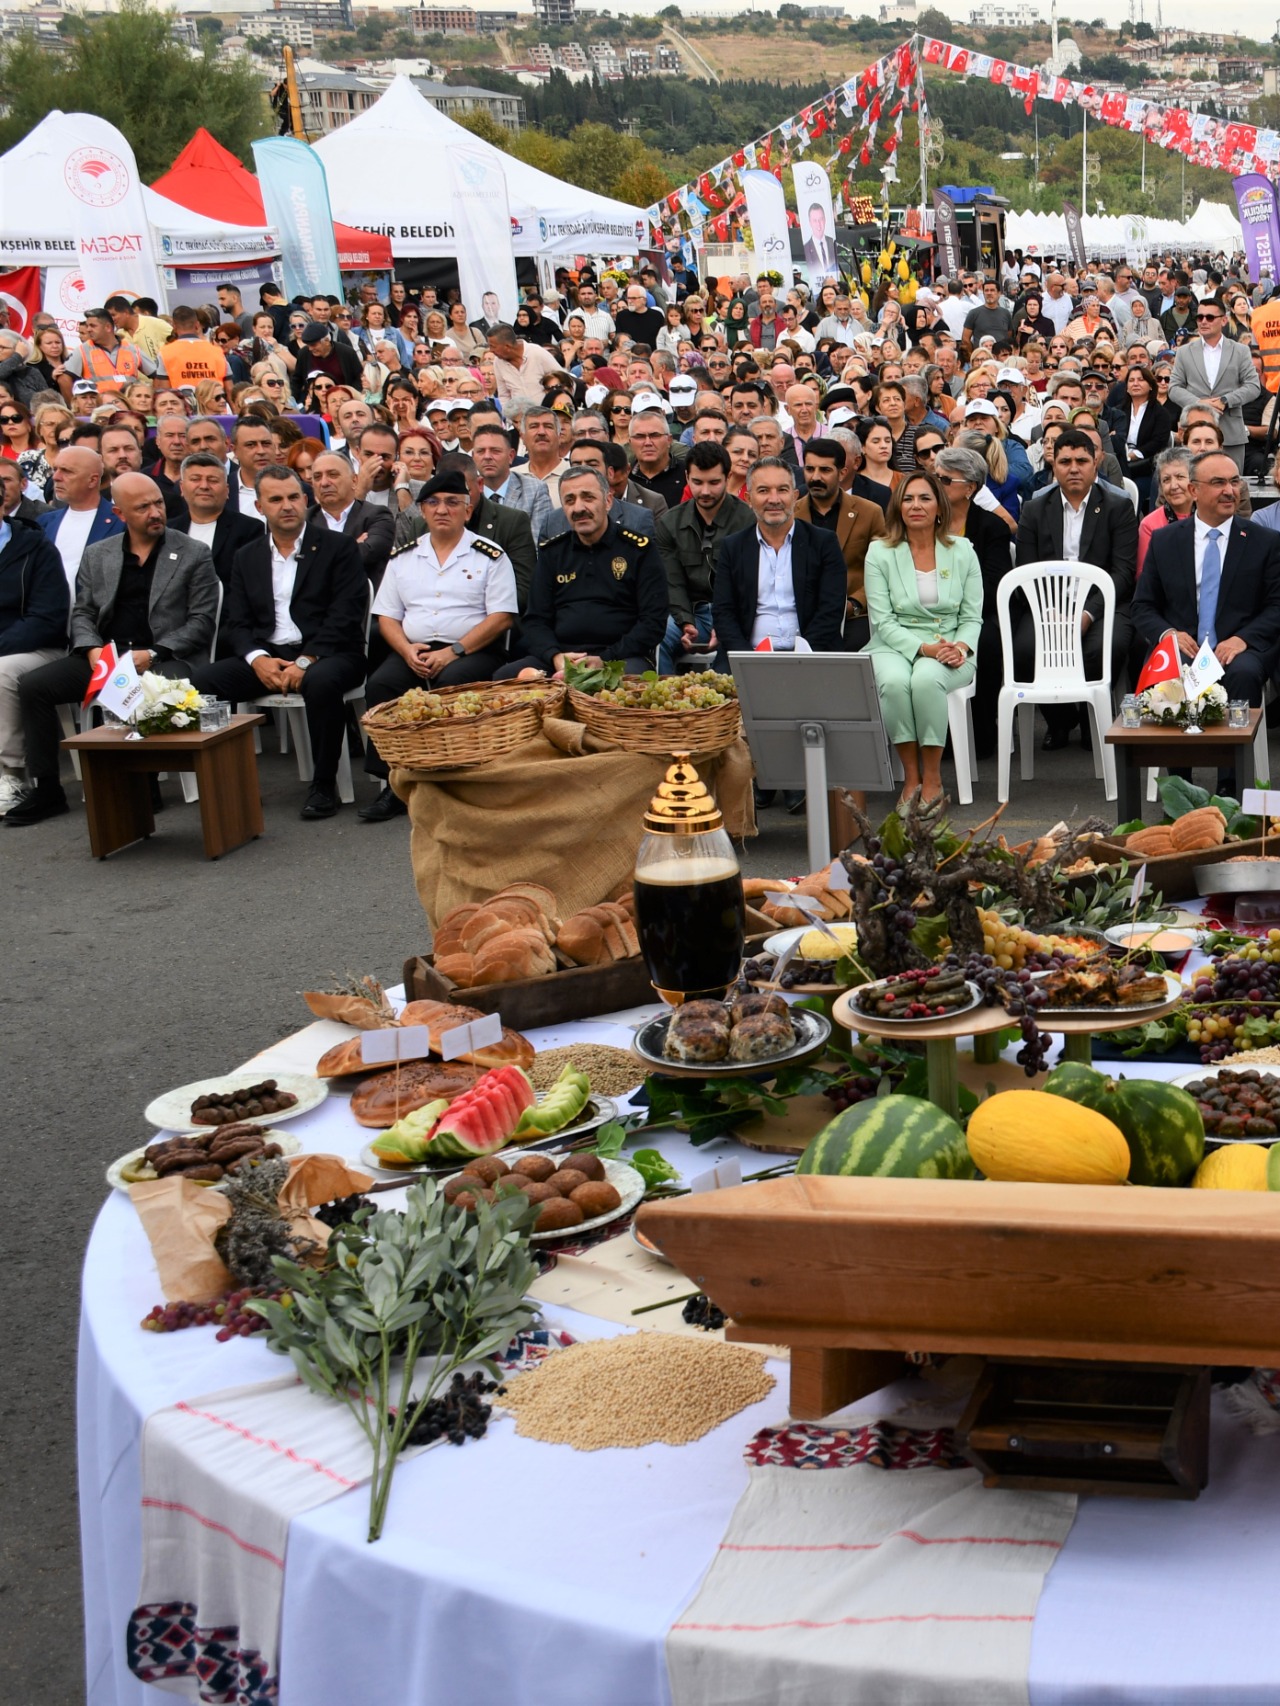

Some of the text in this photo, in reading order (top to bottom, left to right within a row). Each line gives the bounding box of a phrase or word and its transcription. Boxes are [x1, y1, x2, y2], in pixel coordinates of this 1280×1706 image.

[401, 222, 455, 238] BELEDİY
[1, 237, 77, 253] KŞEHİR BELED
[54, 318, 80, 332] TAGE
[185, 361, 209, 370] ÖZEL
[122, 683, 142, 706] TEKİRD
